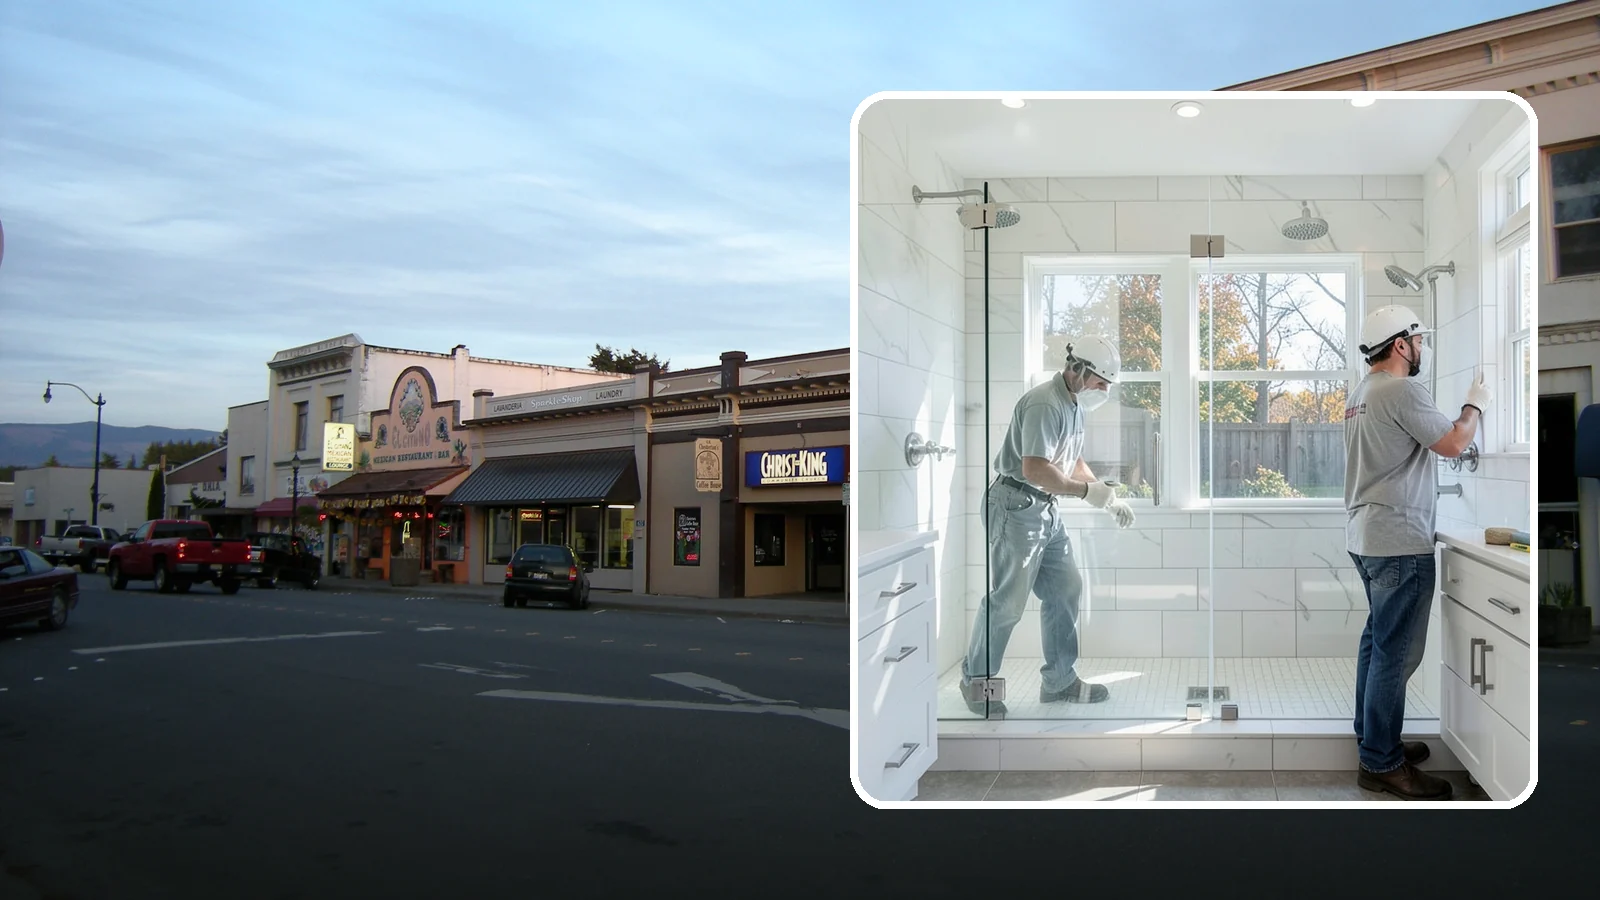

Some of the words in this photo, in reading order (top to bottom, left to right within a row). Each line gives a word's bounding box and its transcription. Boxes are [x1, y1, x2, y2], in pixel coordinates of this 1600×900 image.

[595, 389, 624, 400] LAUNDRY
[493, 402, 523, 412] LAVANDERIA
[373, 455, 397, 464] MEXICAN
[397, 451, 433, 463] RESTAURANT
[438, 450, 450, 459] BAR
[761, 452, 797, 478] CHRIST
[799, 450, 827, 476] KING
